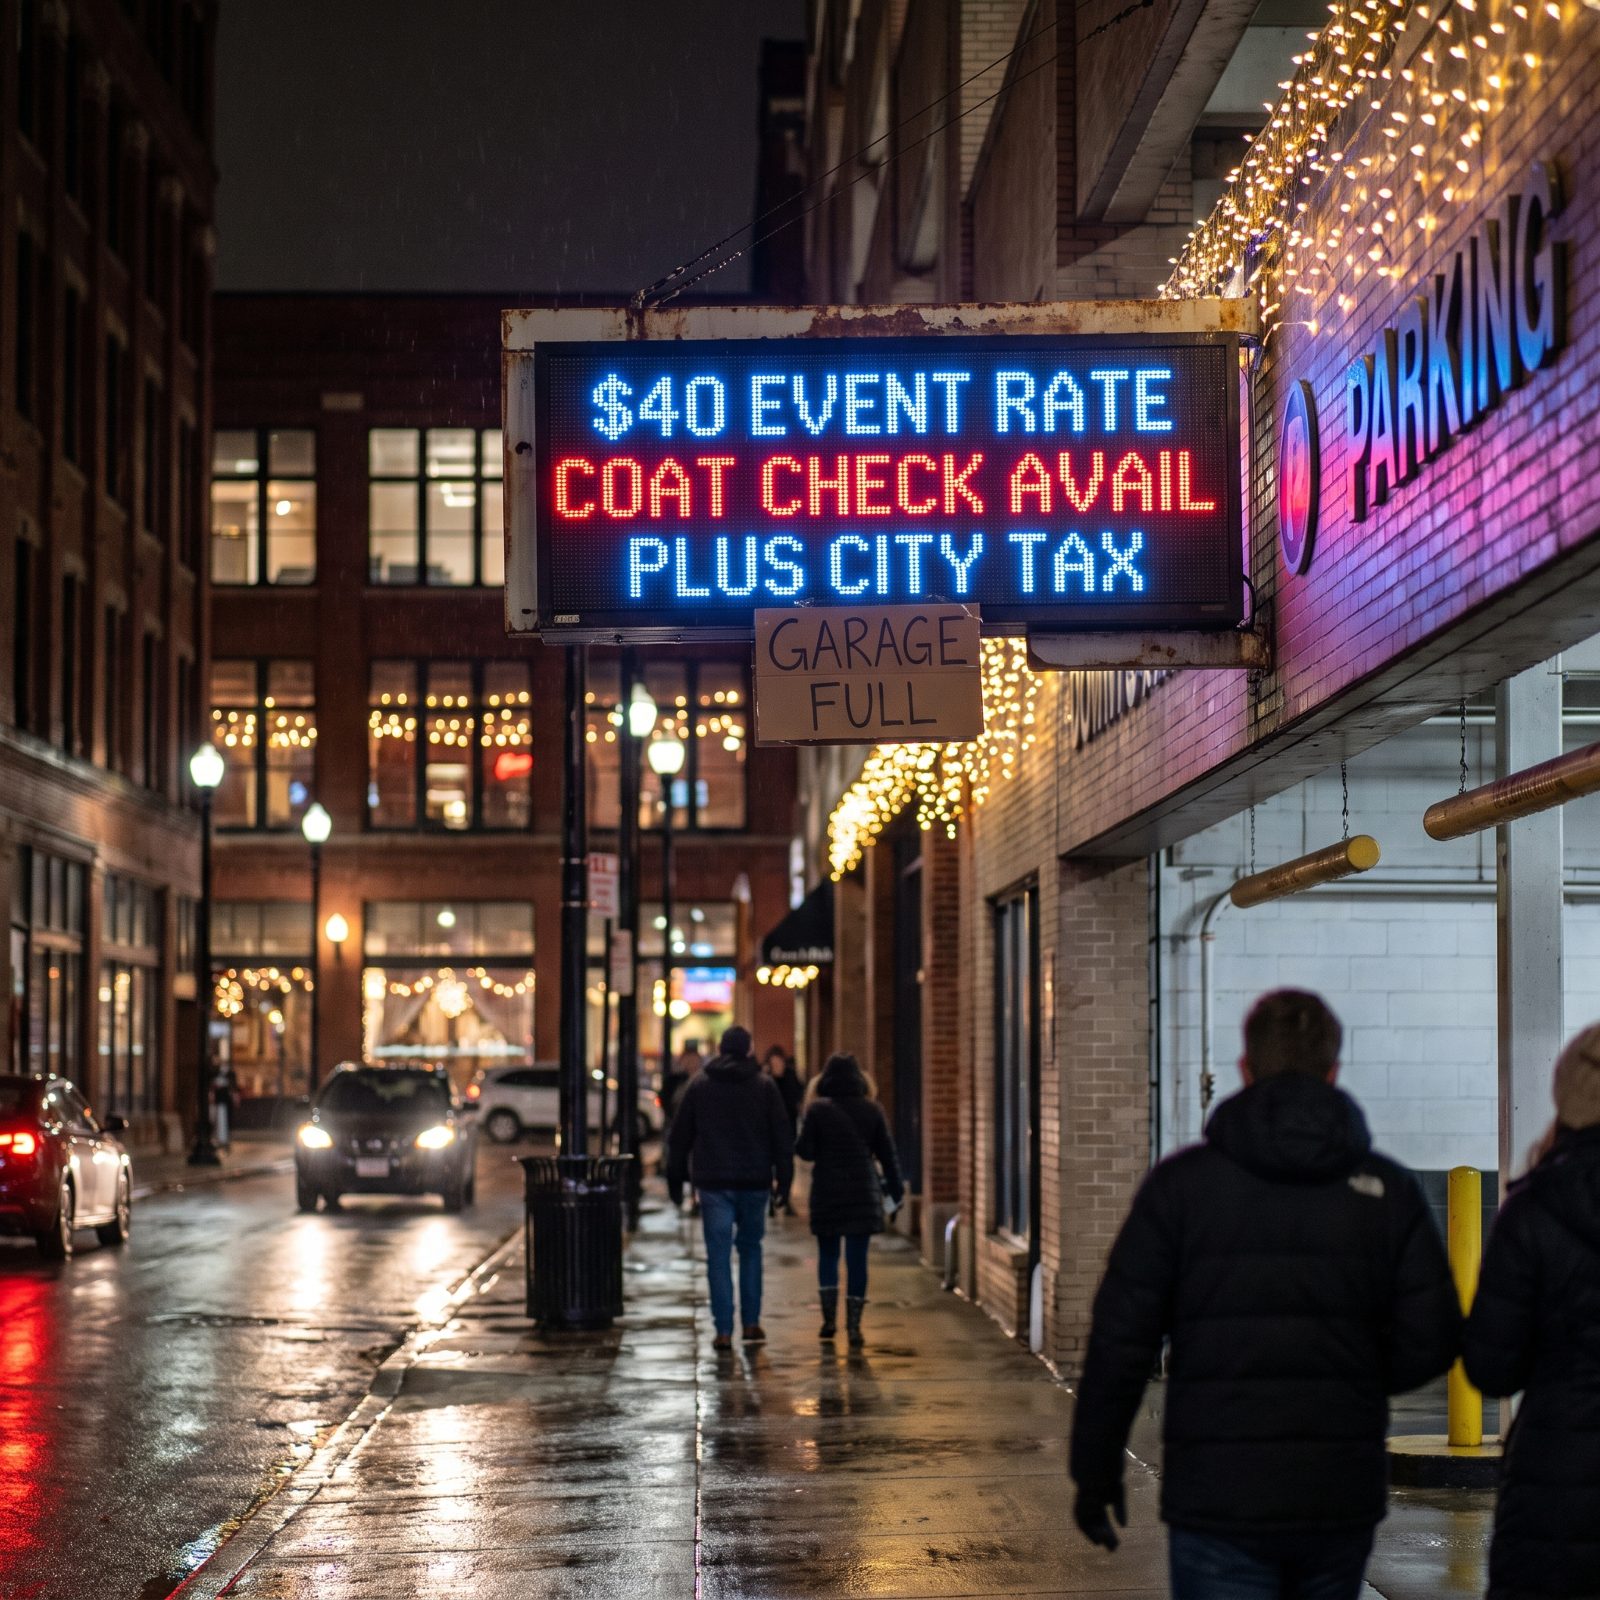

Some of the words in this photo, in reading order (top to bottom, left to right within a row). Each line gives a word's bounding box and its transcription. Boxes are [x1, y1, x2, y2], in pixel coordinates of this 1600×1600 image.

[1346, 160, 1558, 520] PARKING
[593, 374, 725, 440] $40
[752, 373, 970, 435] EVENT
[996, 370, 1172, 432] RATE
[554, 458, 734, 519] COAT
[761, 454, 983, 515] CHECK
[1011, 451, 1214, 513] AVAIL
[630, 536, 804, 597] PLUS
[830, 534, 983, 594] CITY
[1009, 532, 1143, 592] TAX
[769, 616, 967, 671] GARAGE
[810, 681, 937, 731] FULL
